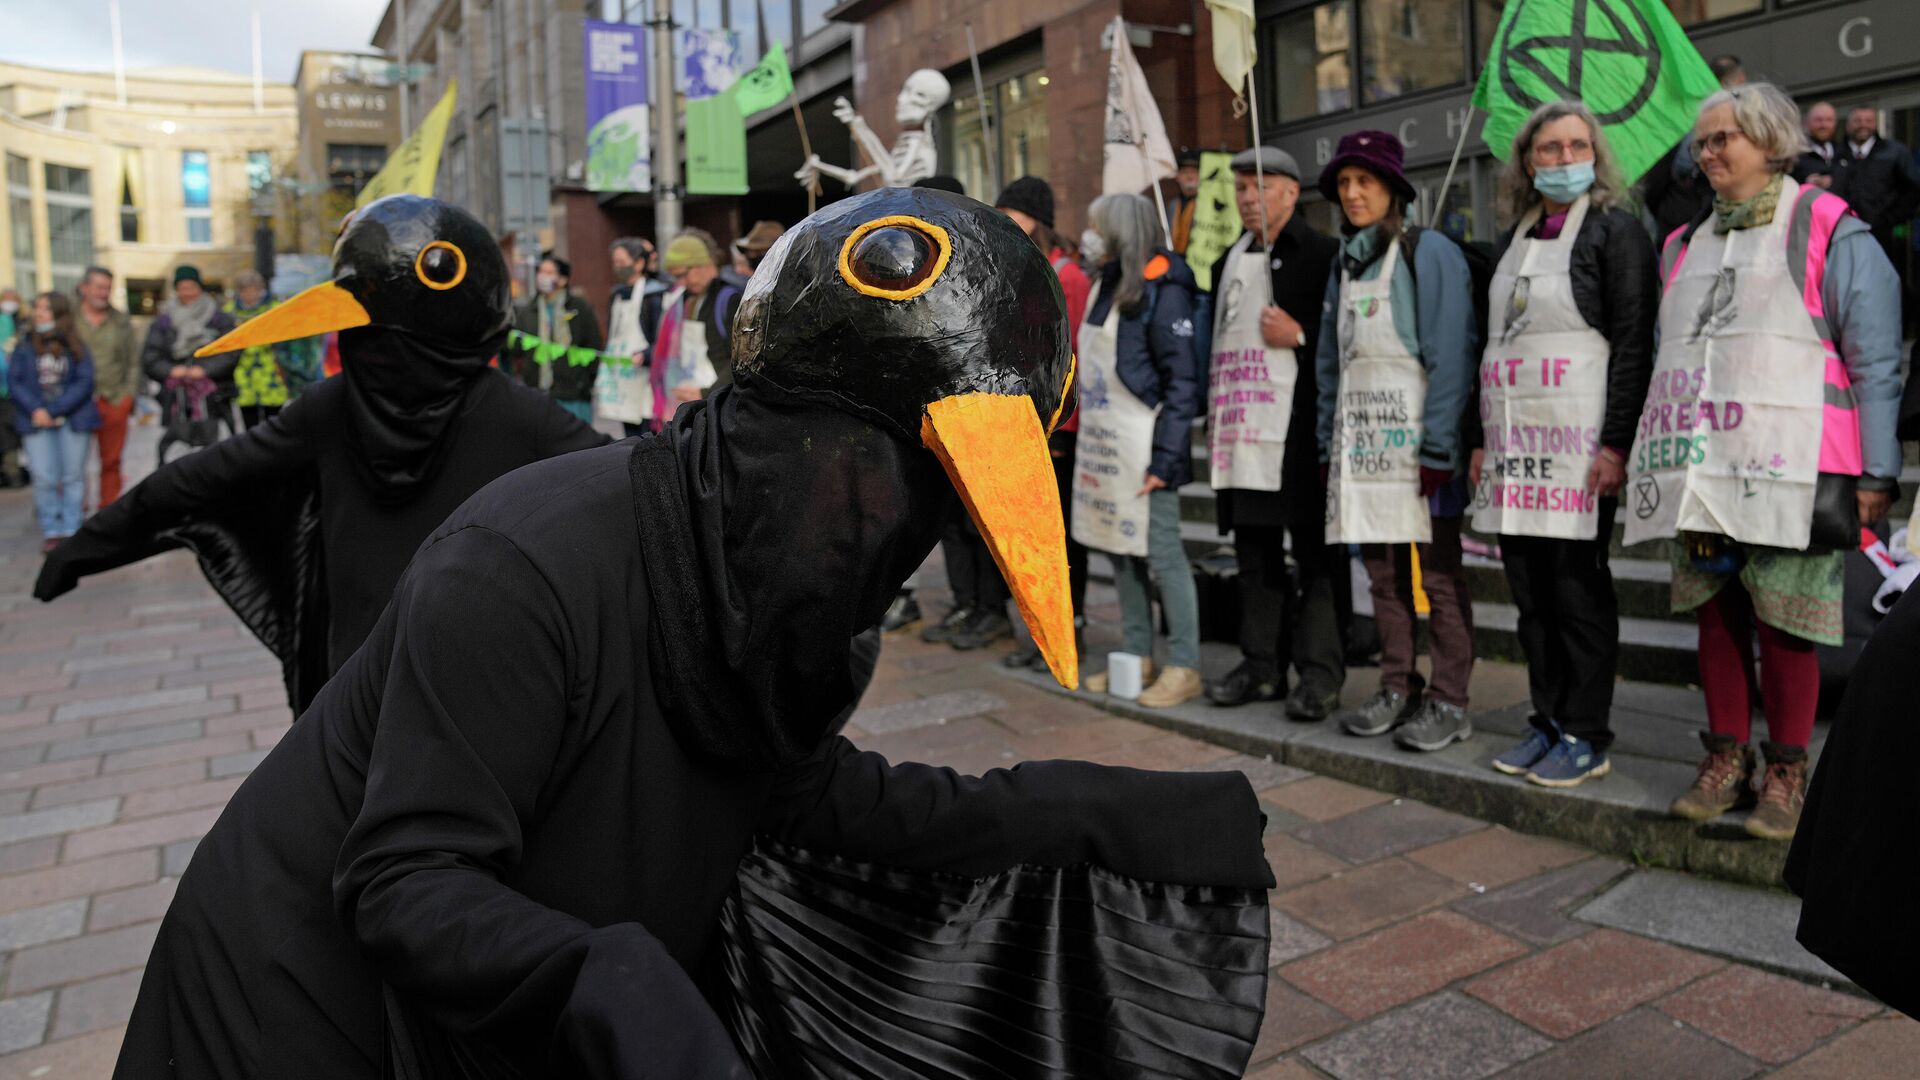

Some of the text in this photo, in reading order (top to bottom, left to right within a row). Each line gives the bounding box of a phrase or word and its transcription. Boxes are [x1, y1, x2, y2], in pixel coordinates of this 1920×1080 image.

[315, 92, 387, 111] LEWIS
[1541, 357, 1571, 388] IF
[1376, 405, 1409, 426] HAS
[1639, 400, 1744, 441] SPREAD
[1354, 429, 1376, 450] BY
[1636, 434, 1708, 473] SEEDS
